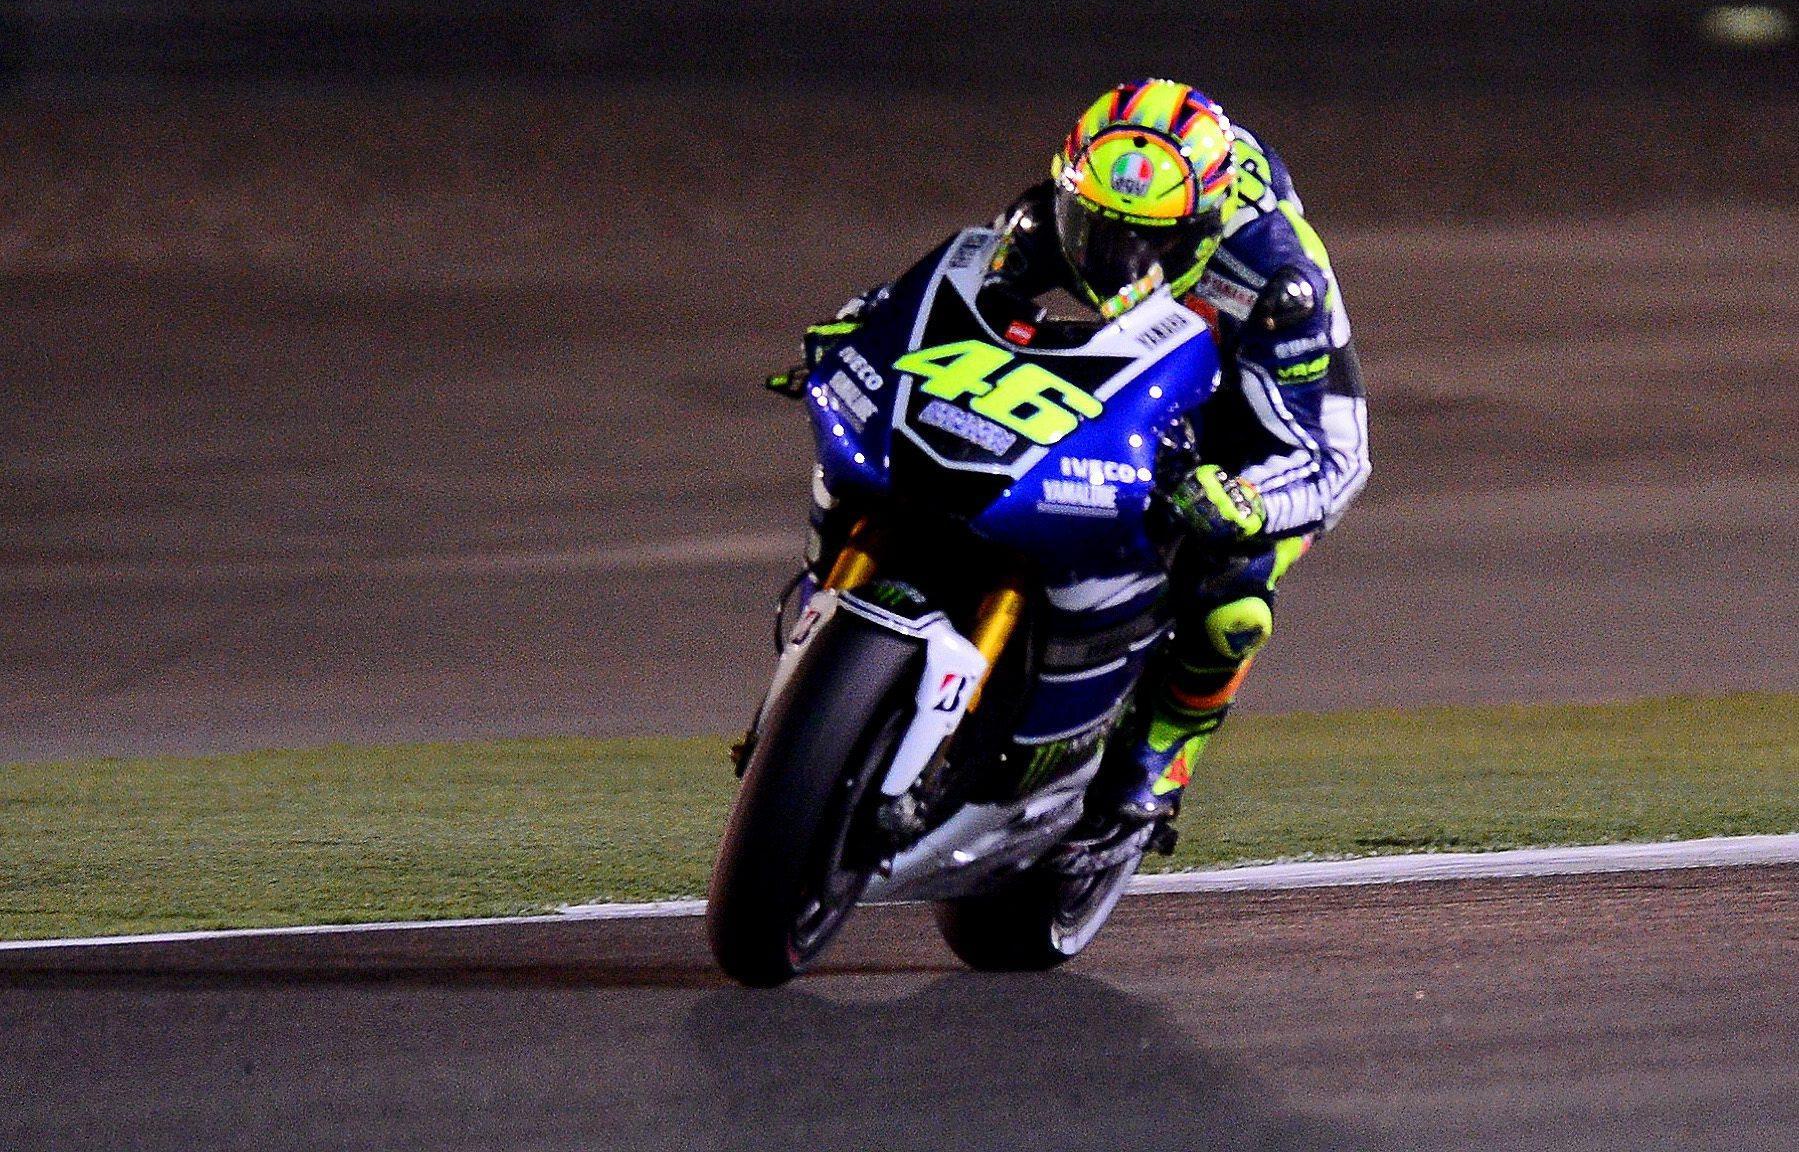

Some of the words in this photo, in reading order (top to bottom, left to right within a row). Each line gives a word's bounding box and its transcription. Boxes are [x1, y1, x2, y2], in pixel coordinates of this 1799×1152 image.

[839, 346, 884, 391] IVECO
[894, 339, 1103, 445] 46
[1060, 456, 1137, 484] IVECO
